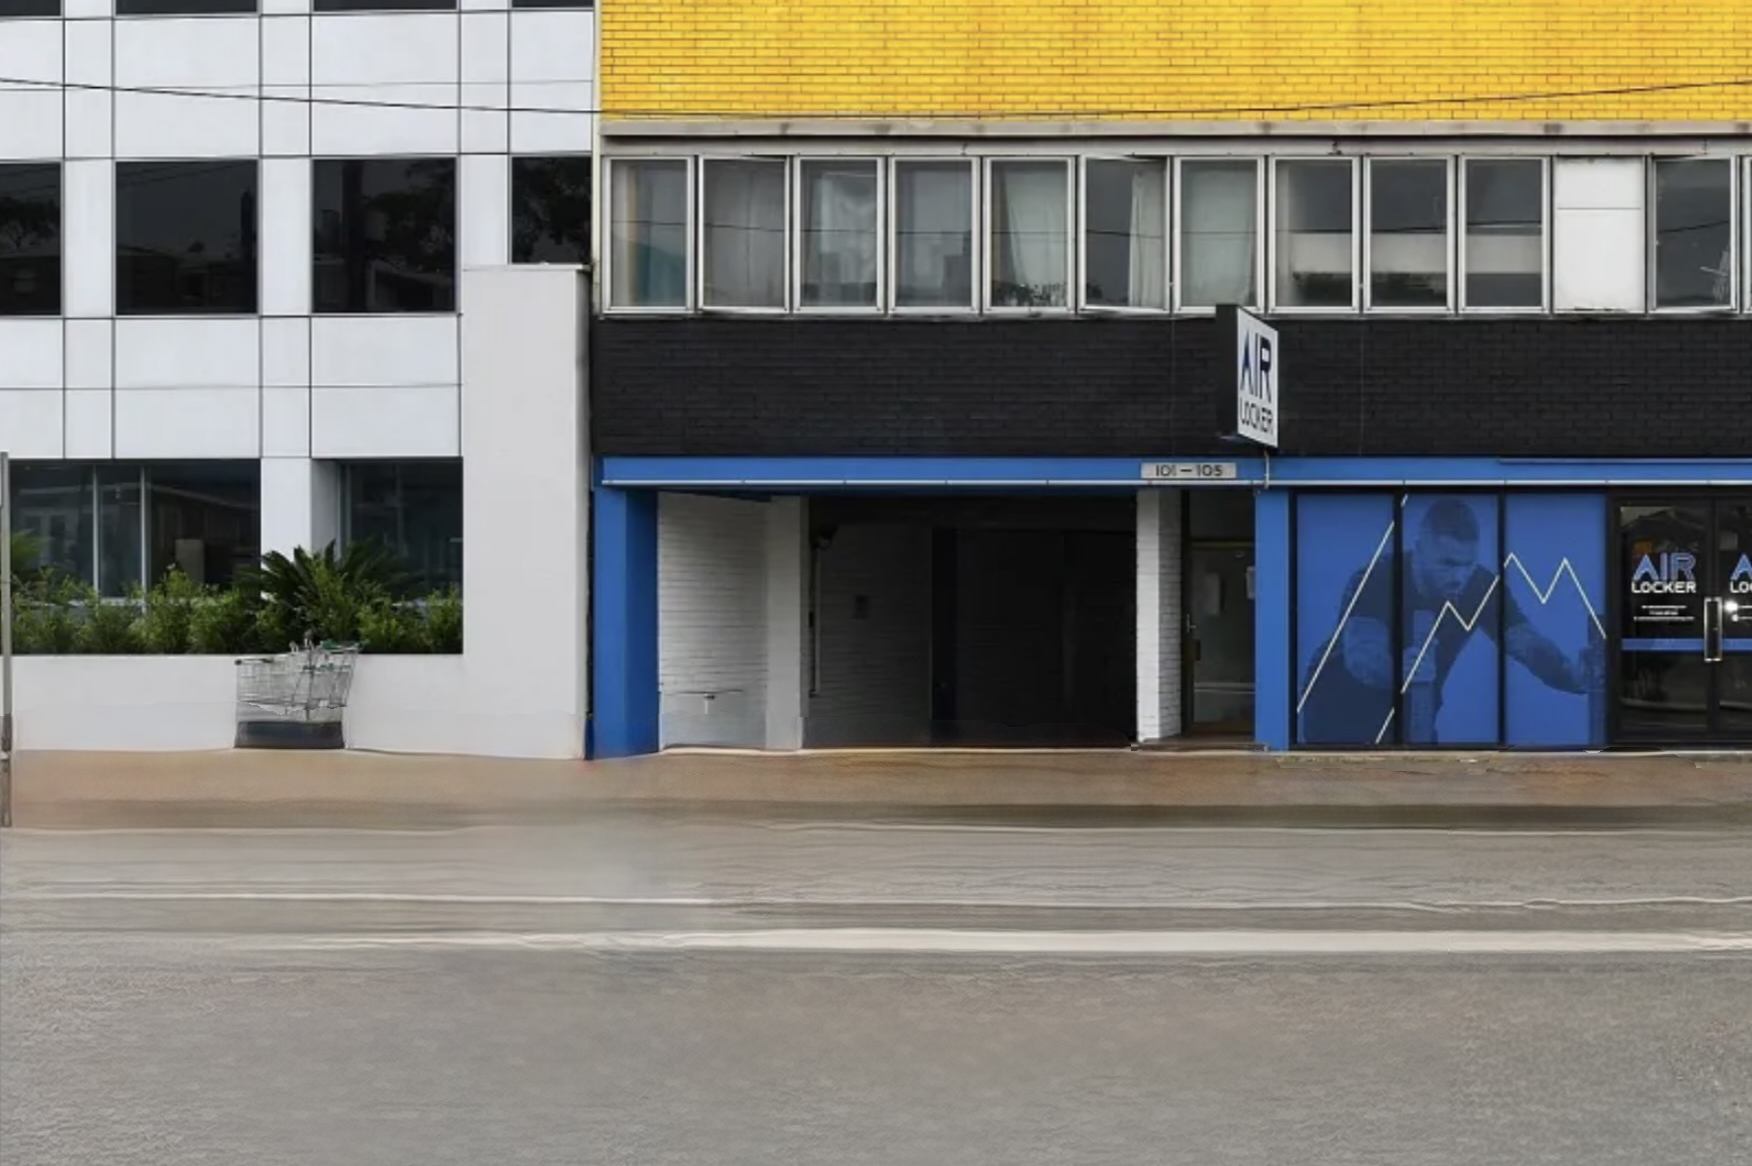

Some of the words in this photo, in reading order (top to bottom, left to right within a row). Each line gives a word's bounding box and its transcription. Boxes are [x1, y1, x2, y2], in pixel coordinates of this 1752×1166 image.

[1240, 329, 1272, 404] AIR
[1632, 553, 1697, 581] AIR
[1631, 581, 1697, 594] LOCKER
